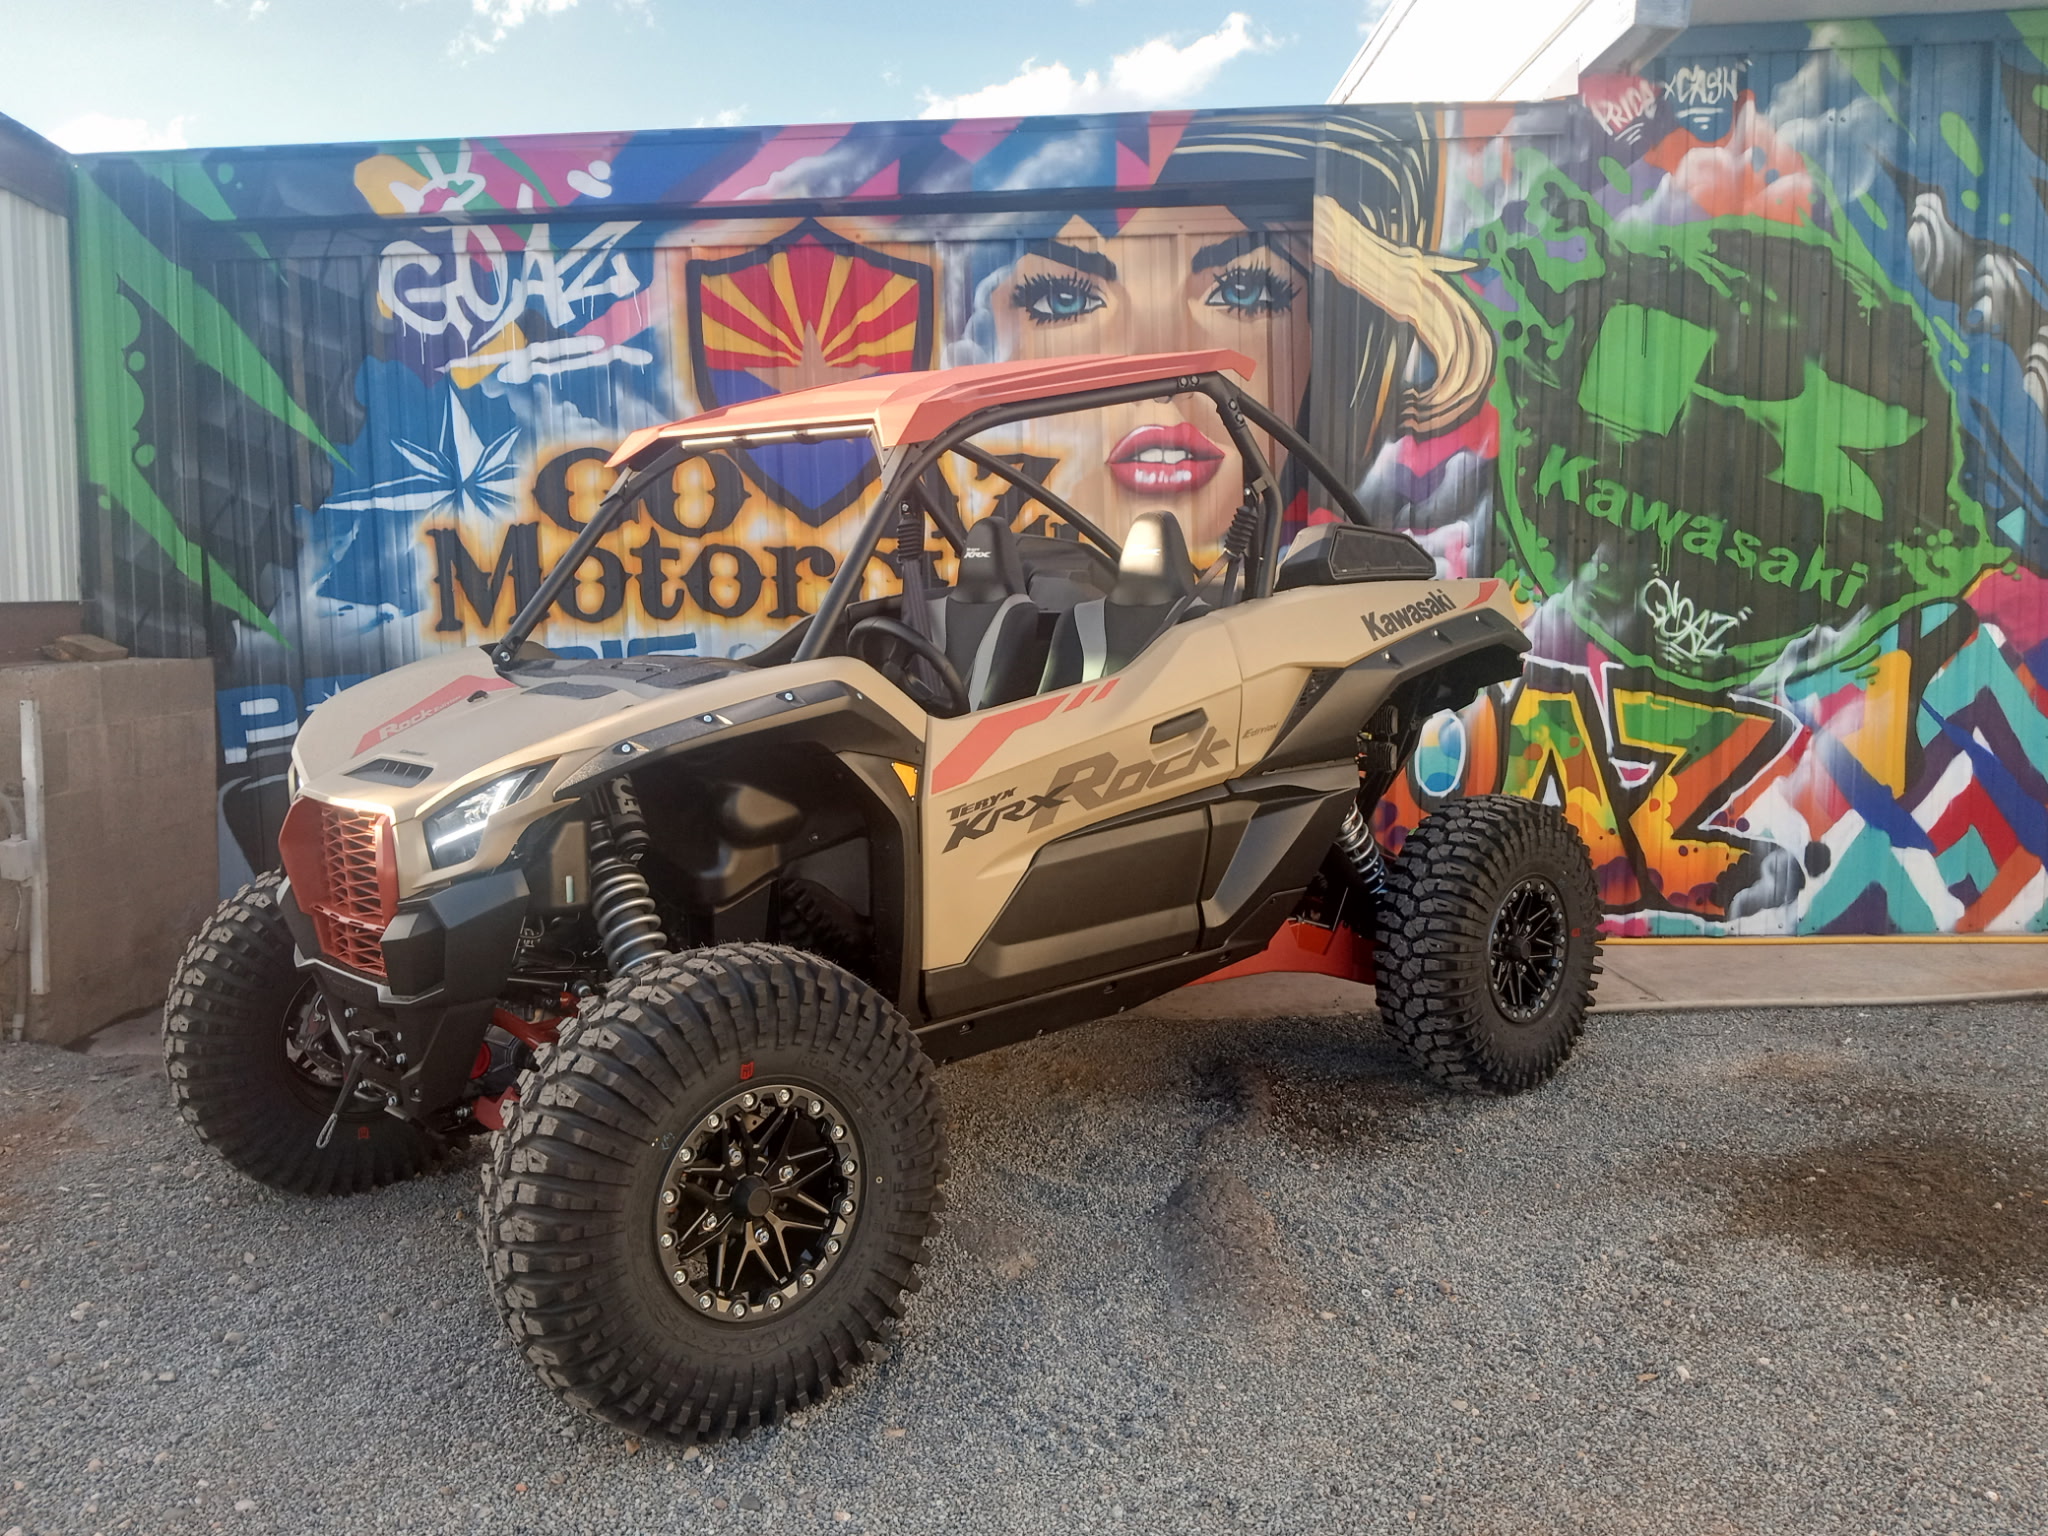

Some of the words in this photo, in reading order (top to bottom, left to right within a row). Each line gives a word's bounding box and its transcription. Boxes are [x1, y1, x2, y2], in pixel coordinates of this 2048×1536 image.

[1533, 443, 1869, 609] Kawasaki
[1361, 589, 1457, 642] Kawasaki
[379, 708, 433, 741] Rock
[942, 782, 1075, 854] KRX
